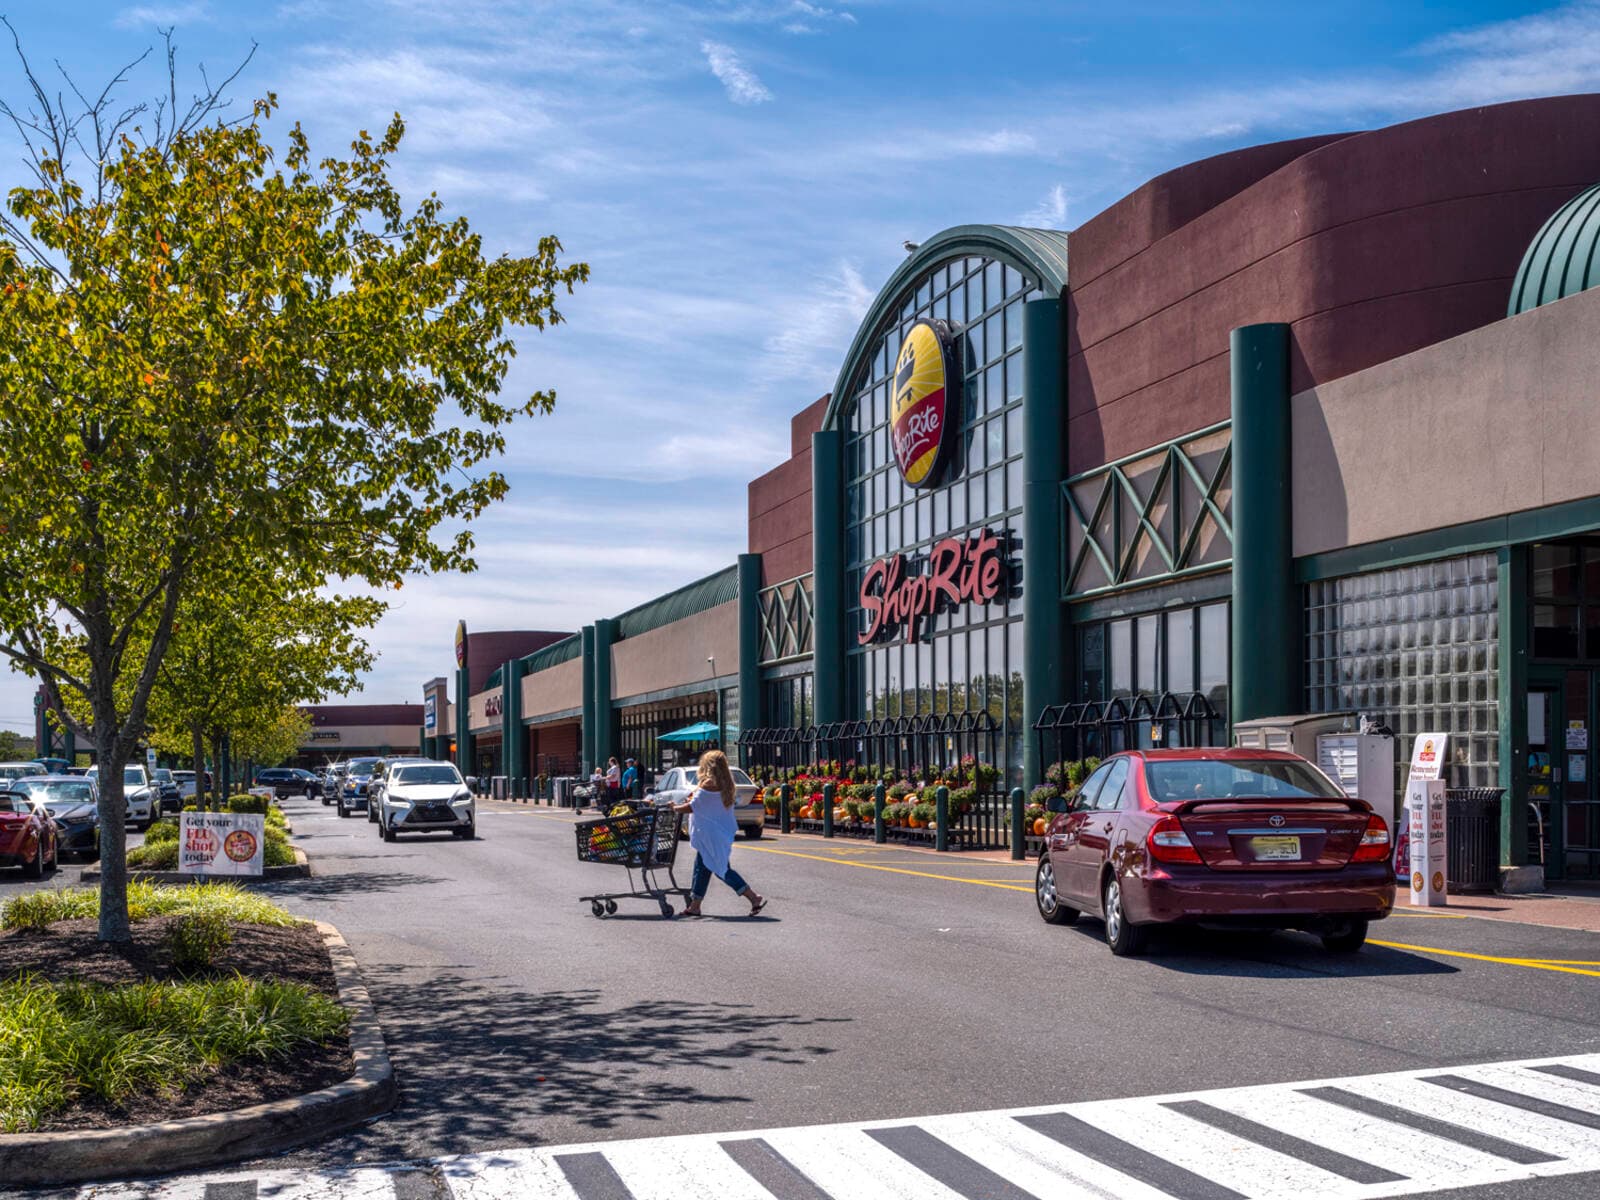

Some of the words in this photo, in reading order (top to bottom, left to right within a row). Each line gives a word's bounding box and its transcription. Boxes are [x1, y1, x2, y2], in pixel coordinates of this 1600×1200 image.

[858, 528, 999, 644] ShopRite
[186, 817, 204, 827] Get
[206, 819, 232, 828] your
[186, 828, 209, 839] FLU
[185, 840, 213, 851] shot
[185, 852, 216, 864] today
